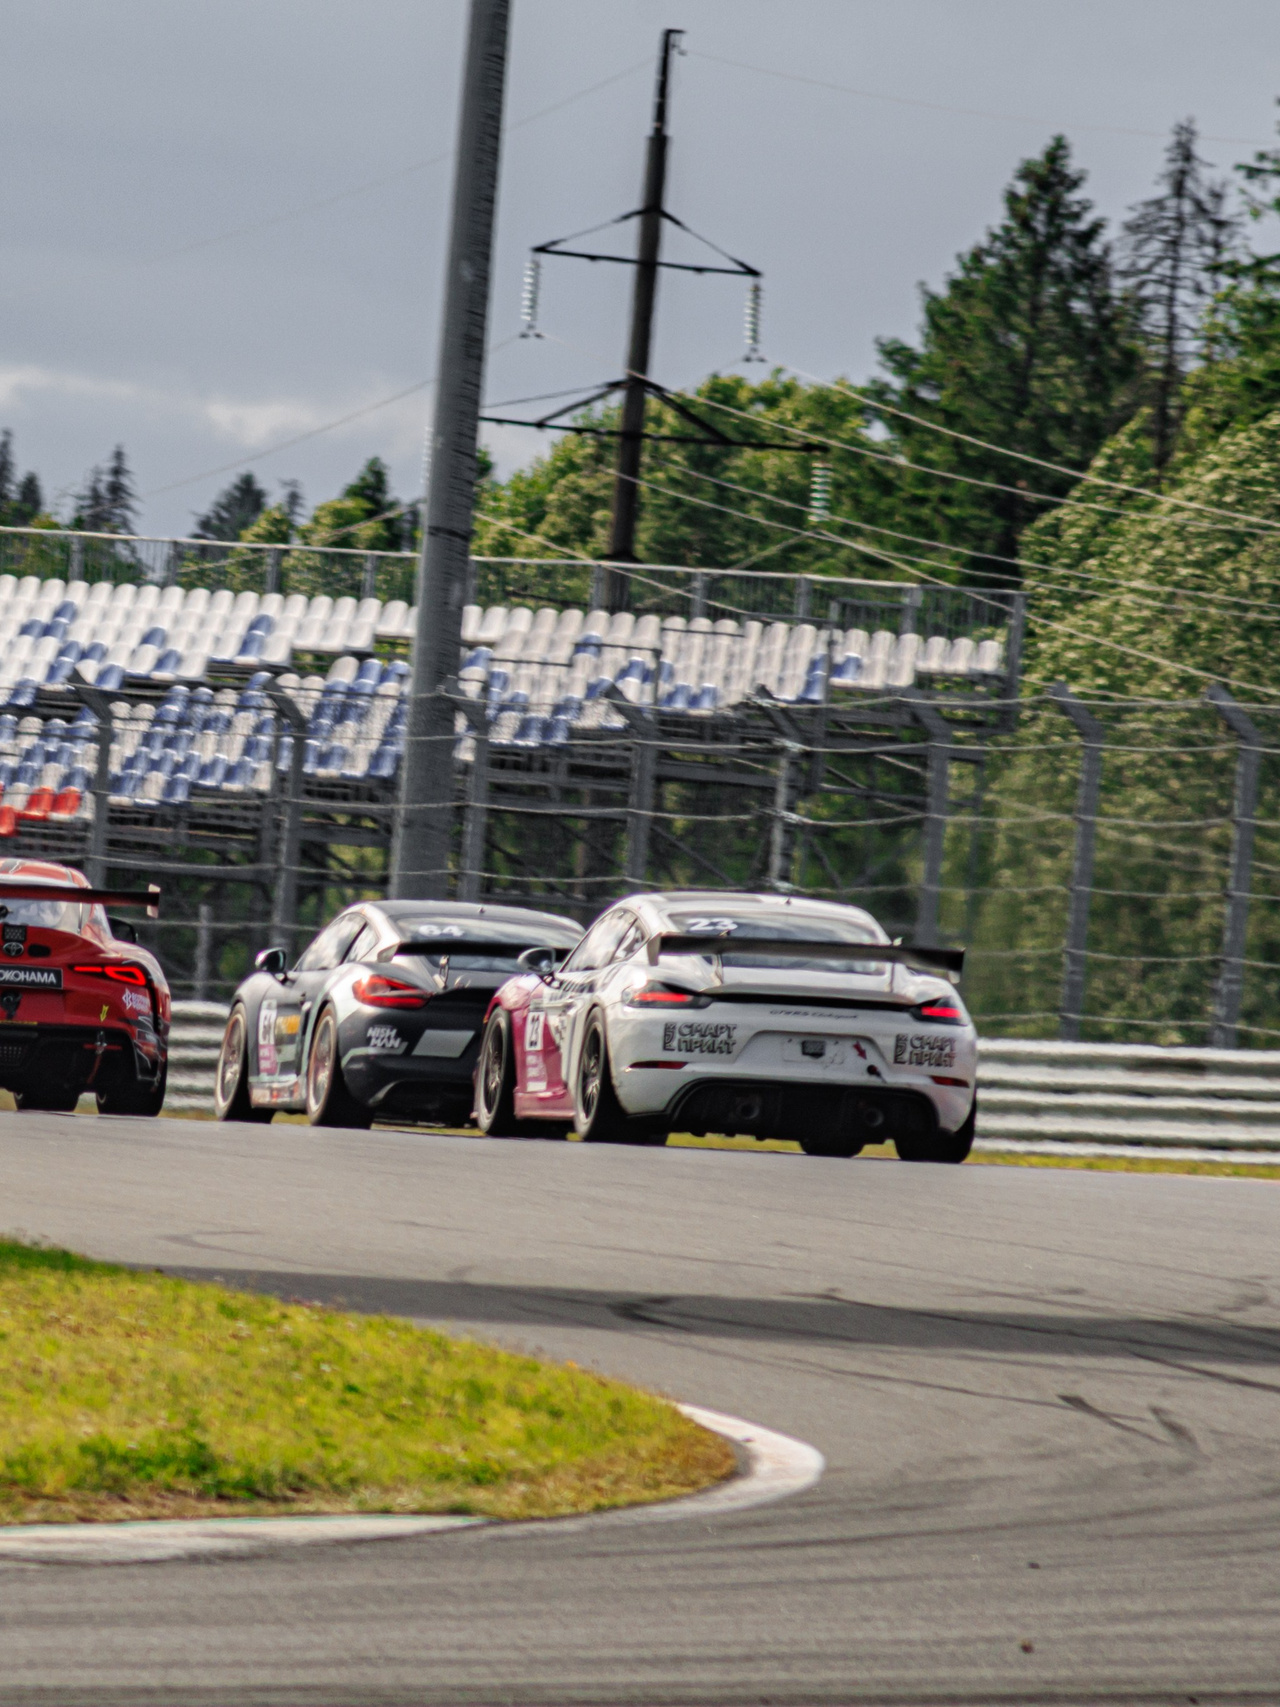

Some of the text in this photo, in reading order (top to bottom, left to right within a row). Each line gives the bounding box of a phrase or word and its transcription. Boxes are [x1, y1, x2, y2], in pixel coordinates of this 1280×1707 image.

[419, 924, 465, 937] 64
[686, 917, 738, 931] 23
[529, 1014, 540, 1048] 23
[678, 1023, 737, 1039] СМАРТ
[677, 1038, 736, 1054] ПРИНТ
